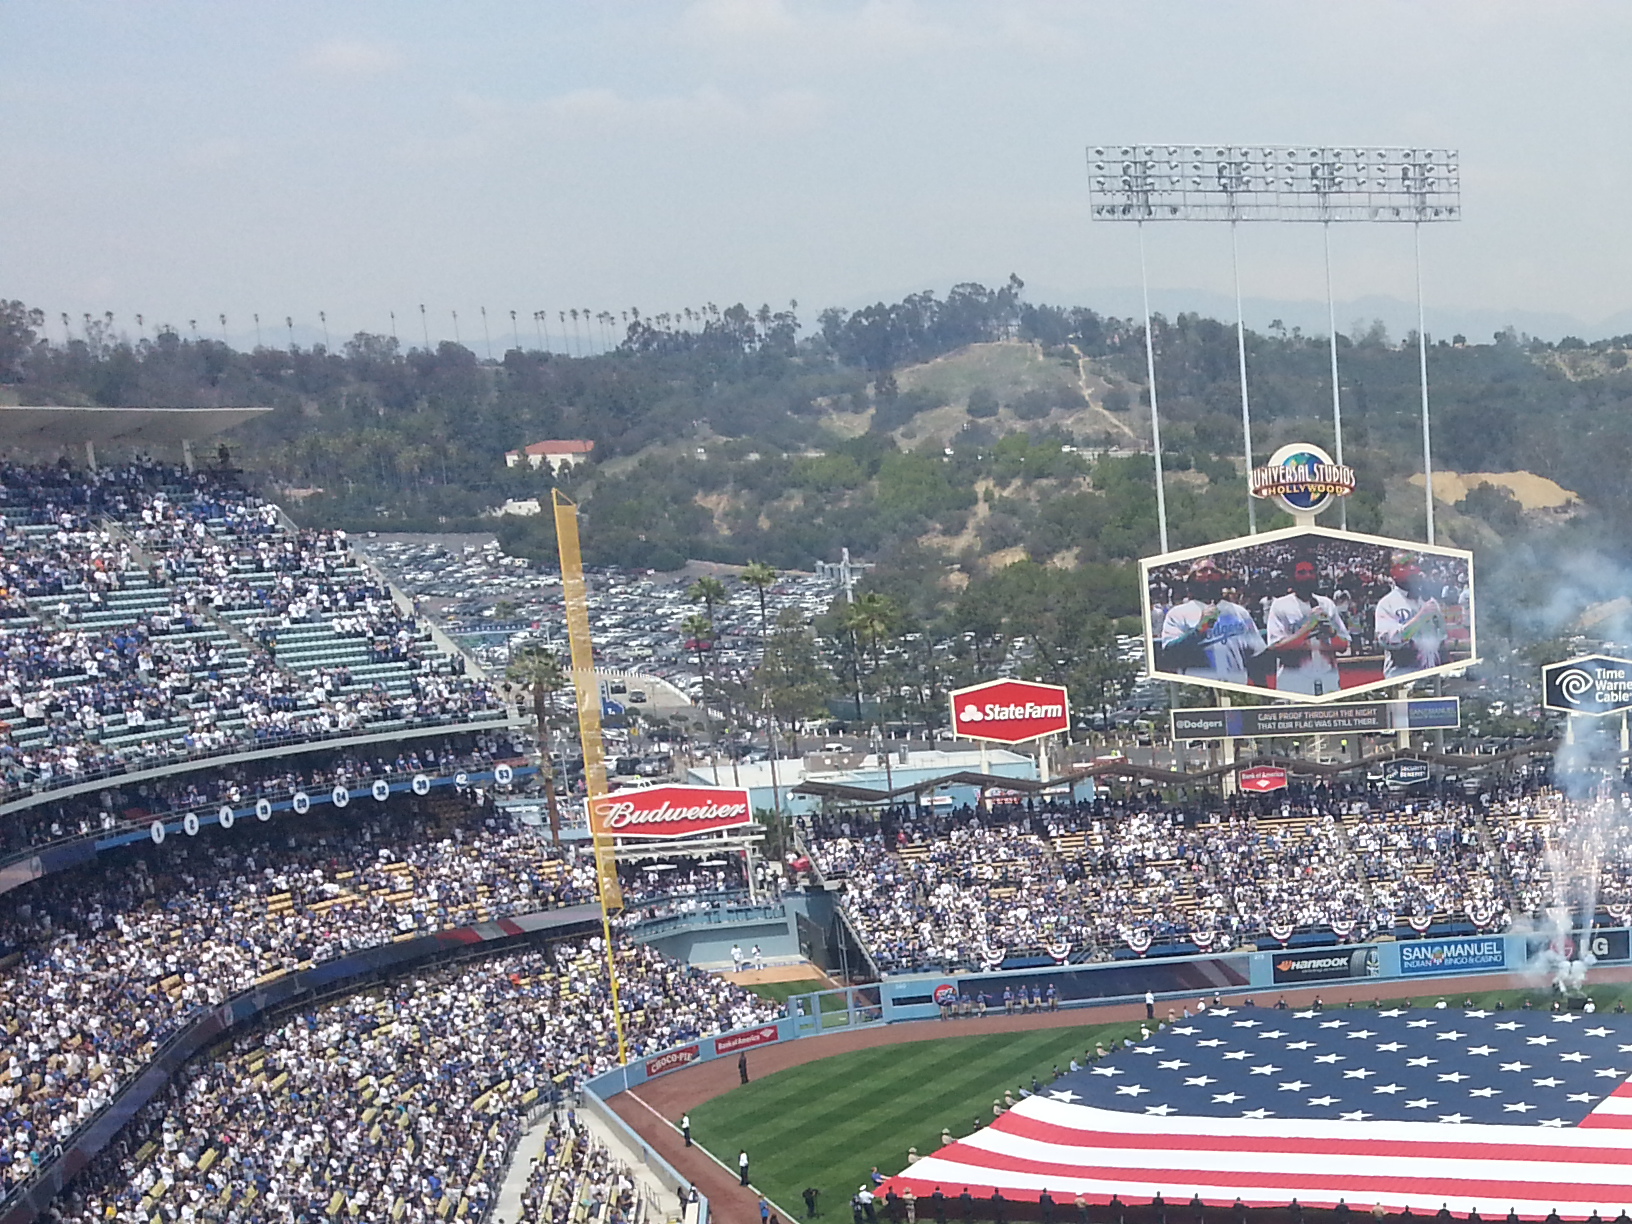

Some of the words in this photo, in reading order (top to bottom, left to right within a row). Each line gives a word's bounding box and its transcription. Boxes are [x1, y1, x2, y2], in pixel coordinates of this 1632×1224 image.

[1254, 465, 1311, 488] UNIVERSAL
[1314, 463, 1355, 487] STUDIOS
[1268, 485, 1343, 495] HOLLYWOOD
[1595, 668, 1625, 679] Time
[1595, 691, 1630, 702] Cable
[1257, 713, 1277, 721] GAVE
[1279, 711, 1302, 720] PROOF
[1304, 710, 1338, 719] THROUGH
[1340, 709, 1353, 717] THE
[1355, 708, 1377, 716] NIGHT
[1176, 719, 1223, 730] @Dodgers
[1257, 722, 1276, 730] THAT
[1278, 721, 1293, 729] OUR
[1295, 720, 1314, 728] FLAG
[1315, 719, 1331, 727] WAS
[1333, 718, 1352, 727] STILL
[1262, 771, 1284, 779] America
[596, 800, 745, 828] Budweiser
[1402, 946, 1432, 961] SAN
[1444, 942, 1502, 958] MANUEL
[1580, 938, 1609, 956] LG
[1404, 960, 1432, 968] INDIAN
[1444, 957, 1468, 966] BINGO
[1474, 954, 1502, 964] CASINO
[718, 1041, 731, 1050] Bank
[737, 1034, 760, 1046] America
